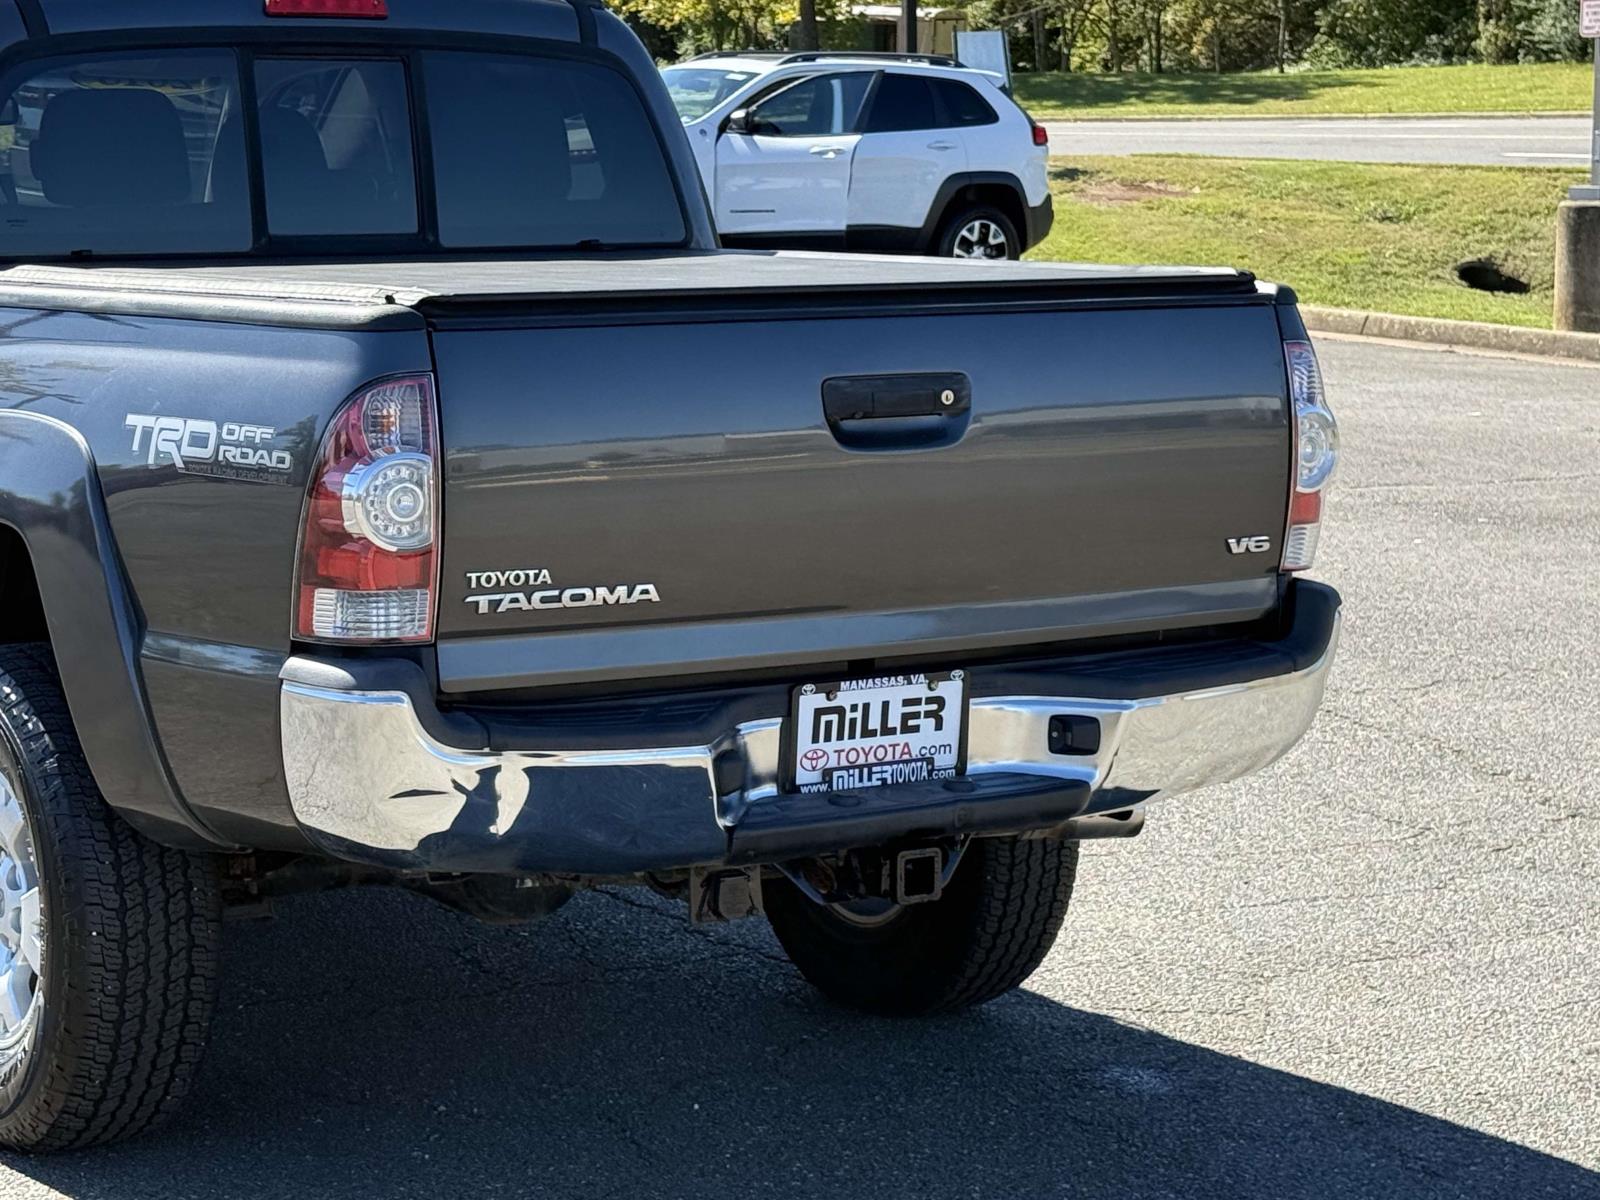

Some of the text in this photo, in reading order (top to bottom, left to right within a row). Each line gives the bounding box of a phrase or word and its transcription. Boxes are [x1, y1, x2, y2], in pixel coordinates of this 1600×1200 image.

[125, 413, 217, 468] TRD
[221, 424, 275, 443] OFF
[218, 445, 292, 469] ROAD
[1227, 535, 1270, 554] V6
[466, 569, 552, 588] TOYOTA
[464, 583, 661, 614] TACOMA
[840, 676, 907, 691] MANASSAS,
